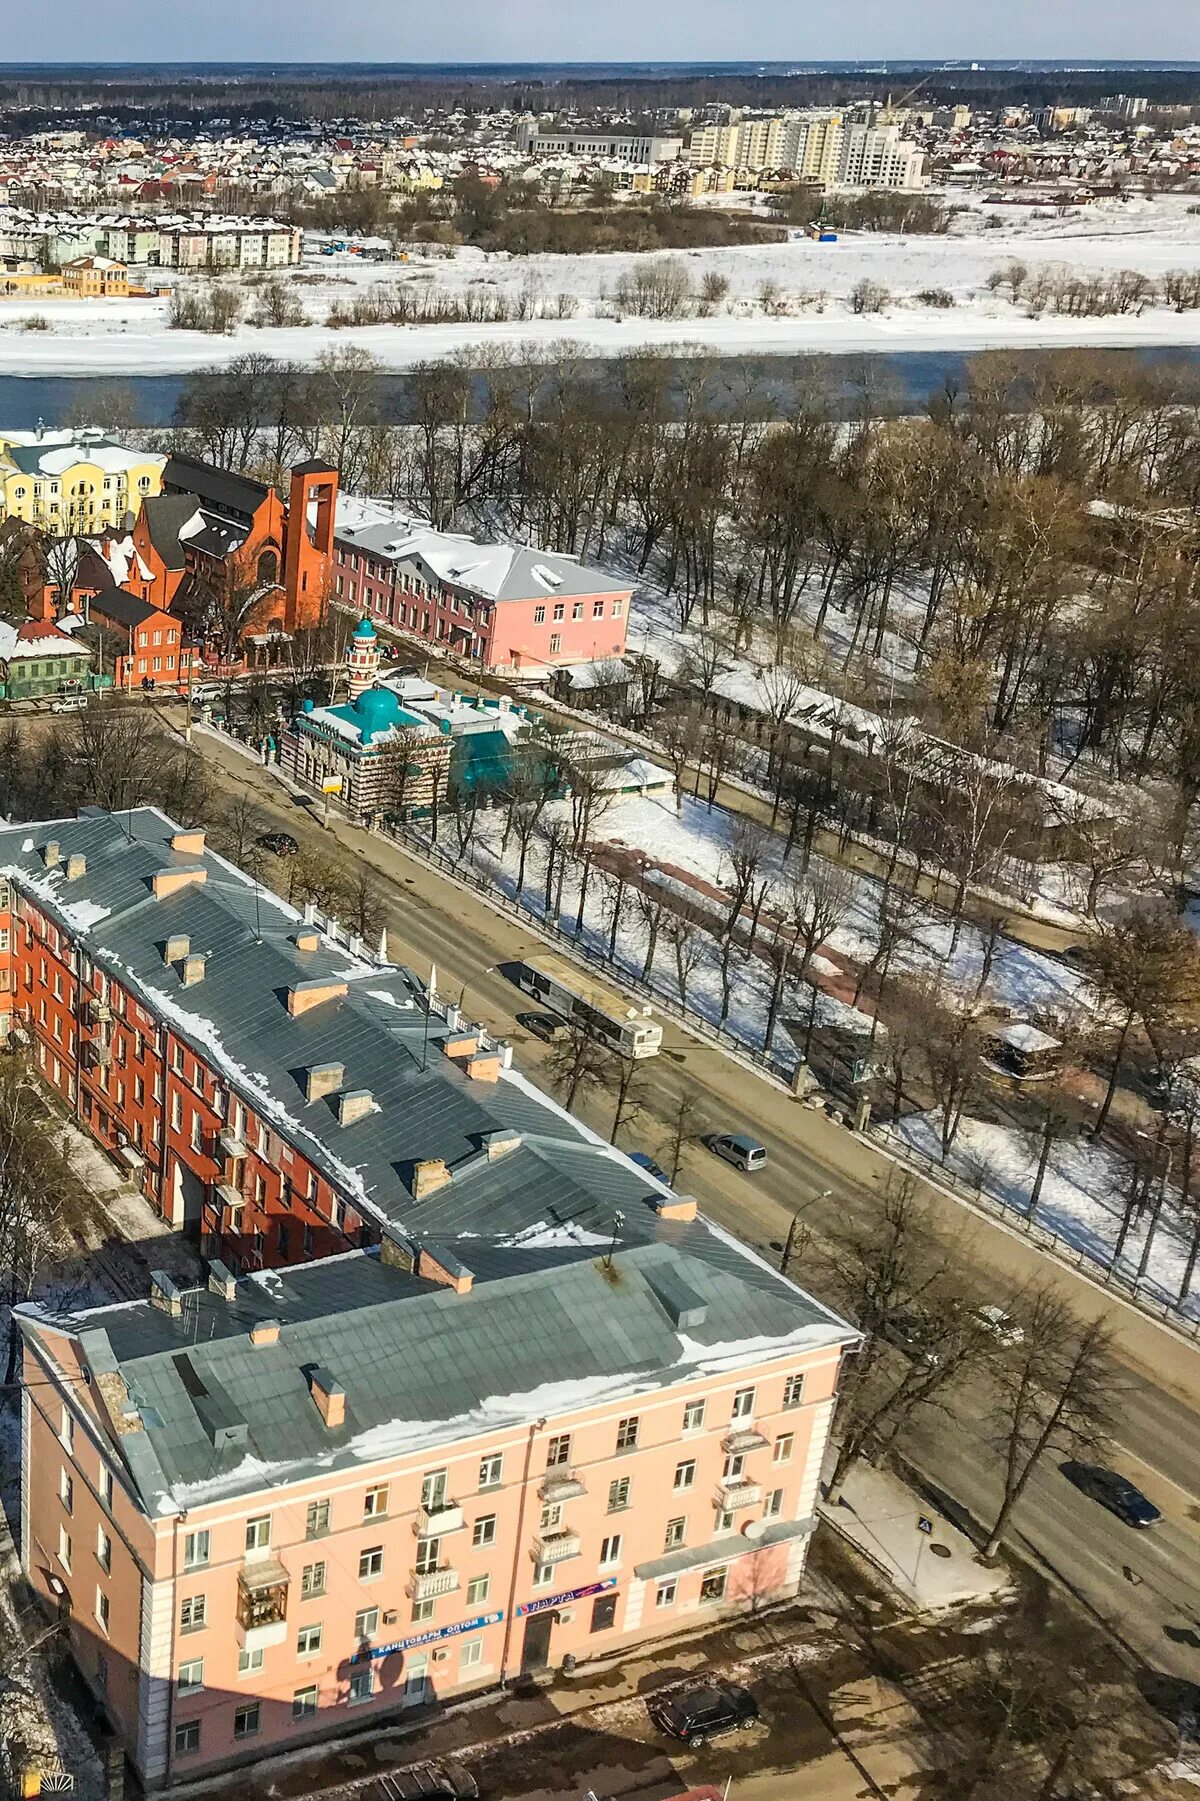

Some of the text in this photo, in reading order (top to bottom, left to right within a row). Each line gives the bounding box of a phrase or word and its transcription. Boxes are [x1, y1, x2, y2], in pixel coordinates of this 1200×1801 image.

[530, 1592, 574, 1611] ПАРТА
[378, 1630, 442, 1654] КАНЦТОВАРЫ
[446, 1618, 479, 1633] ОПТОМ
